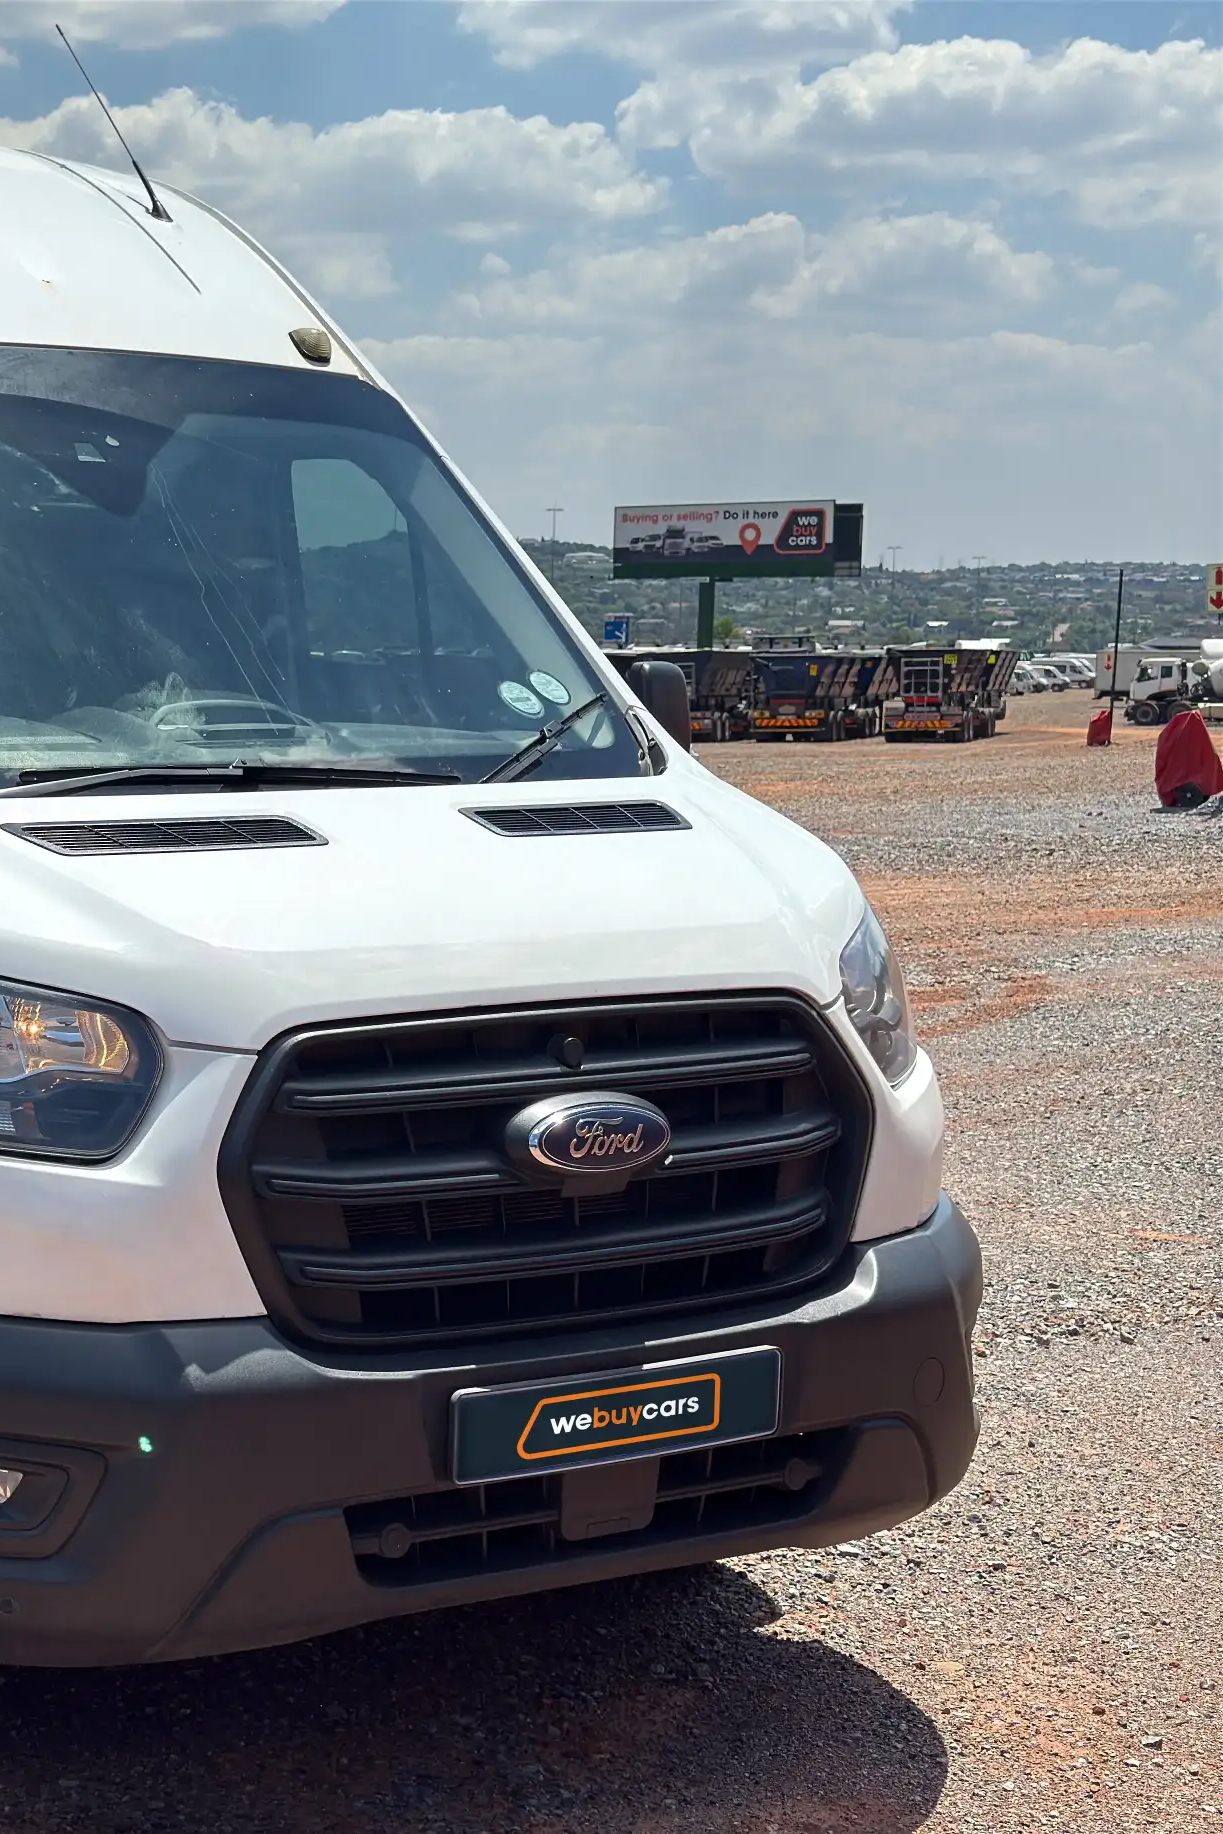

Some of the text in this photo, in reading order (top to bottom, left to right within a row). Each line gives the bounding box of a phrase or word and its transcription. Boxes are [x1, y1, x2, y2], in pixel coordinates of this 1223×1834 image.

[622, 509, 778, 524] Buying or selling? Do it here
[797, 516, 818, 525] we
[793, 525, 817, 535] buy
[788, 536, 817, 545] cars
[569, 1117, 644, 1158] Ford
[550, 1395, 699, 1435] webuycars
